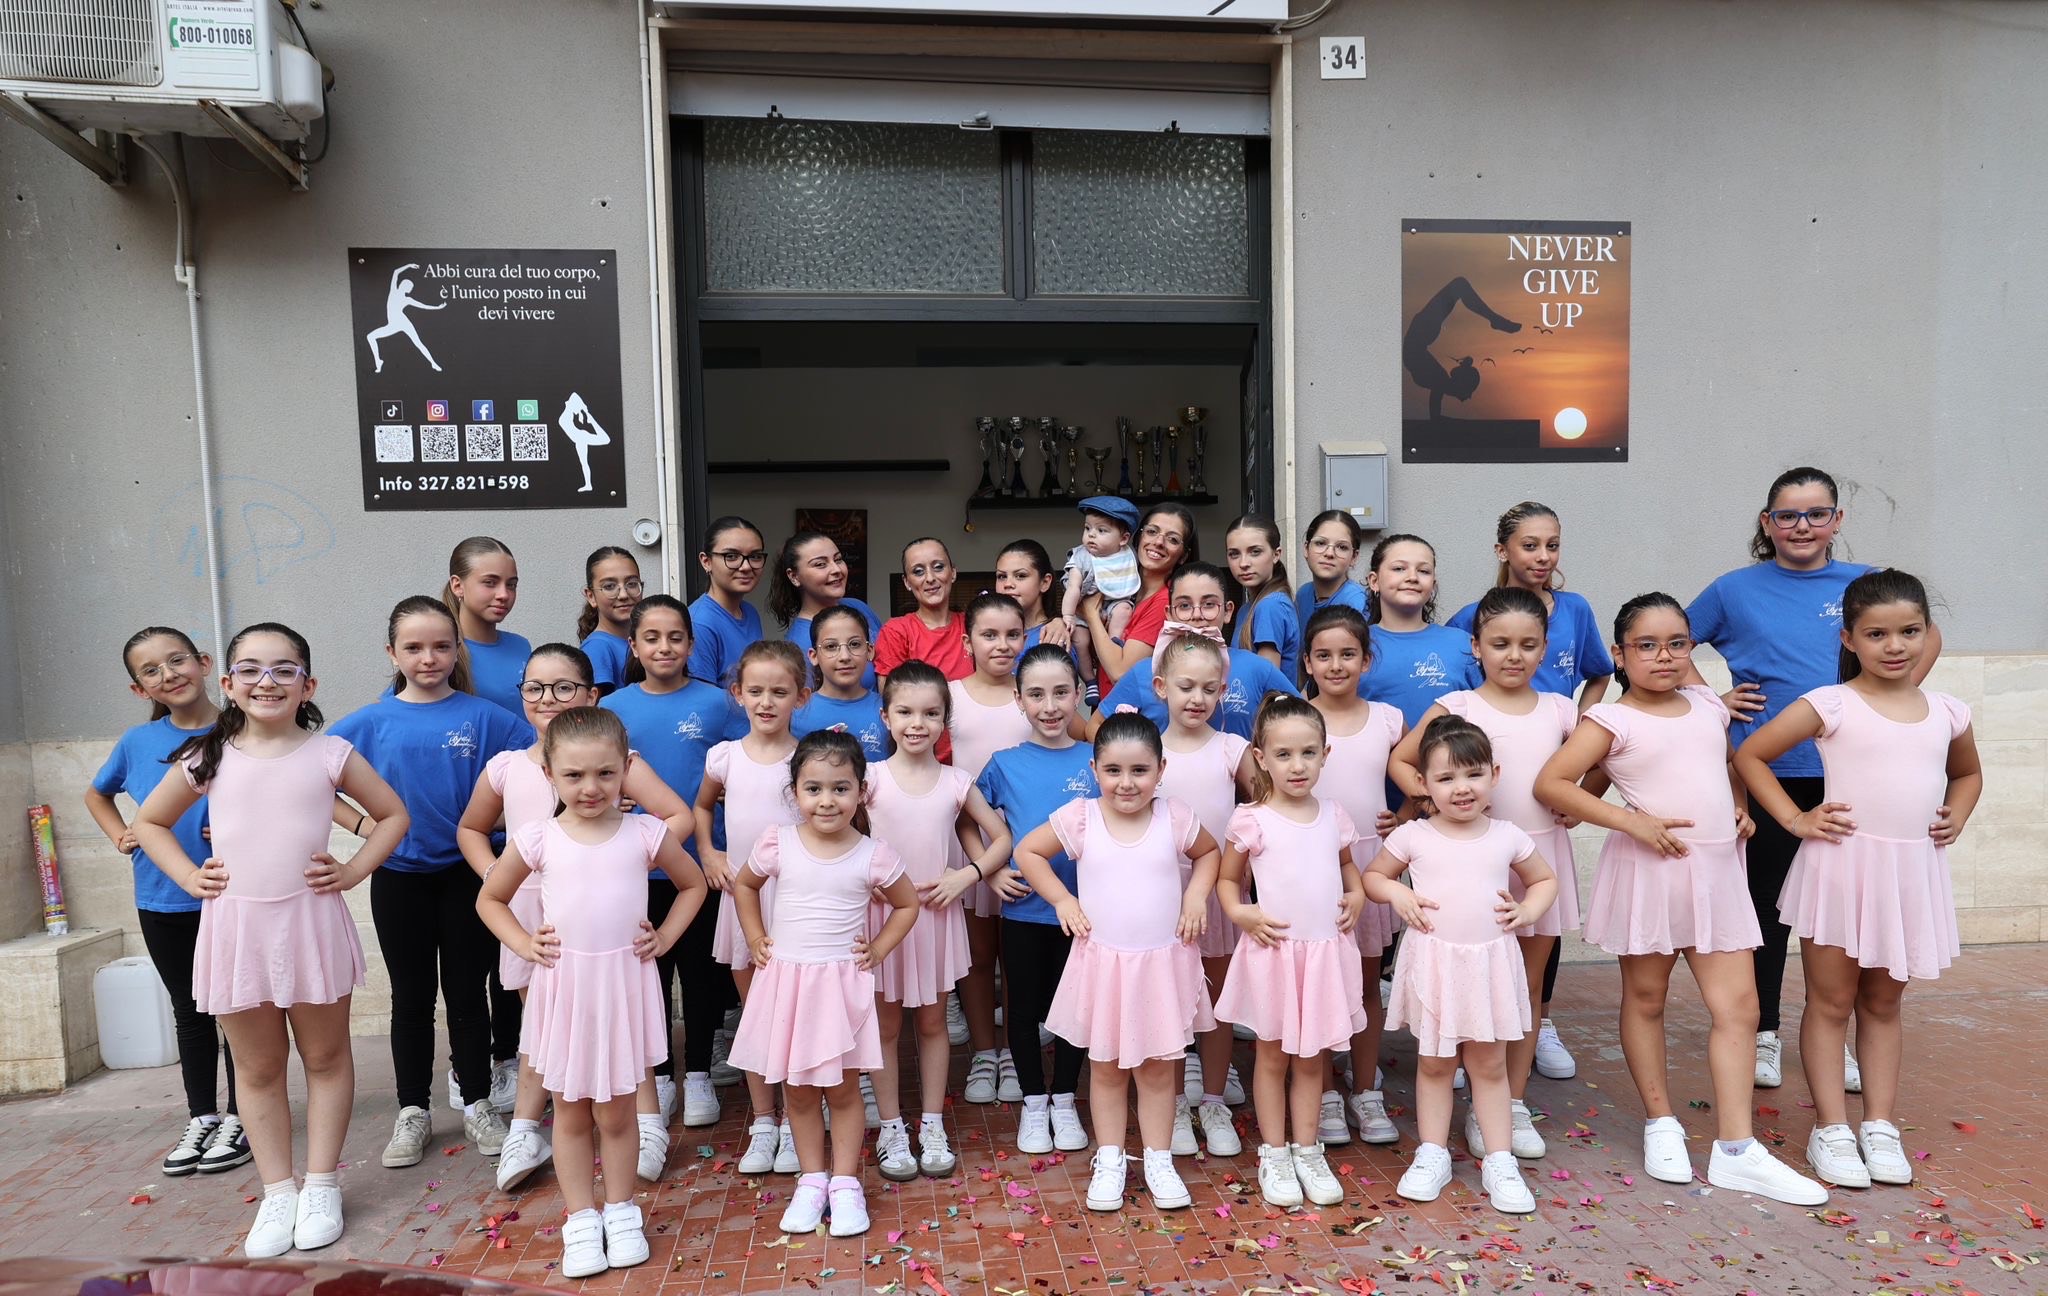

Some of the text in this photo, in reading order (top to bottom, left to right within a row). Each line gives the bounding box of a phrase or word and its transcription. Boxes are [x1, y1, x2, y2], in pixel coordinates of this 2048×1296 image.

[180, 26, 253, 45] 800-010068
[1331, 45, 1357, 69] 34
[1507, 235, 1617, 262] NEVER
[424, 264, 601, 283] Abbi cura del tuo corpo,
[1523, 269, 1600, 295] GIVE
[440, 285, 448, 298] è
[503, 288, 543, 303] posto
[548, 286, 561, 299] in
[565, 286, 586, 299] cui
[478, 306, 555, 320] devi vivere
[1541, 303, 1582, 327] UP
[380, 476, 529, 490] Info 327.821598
